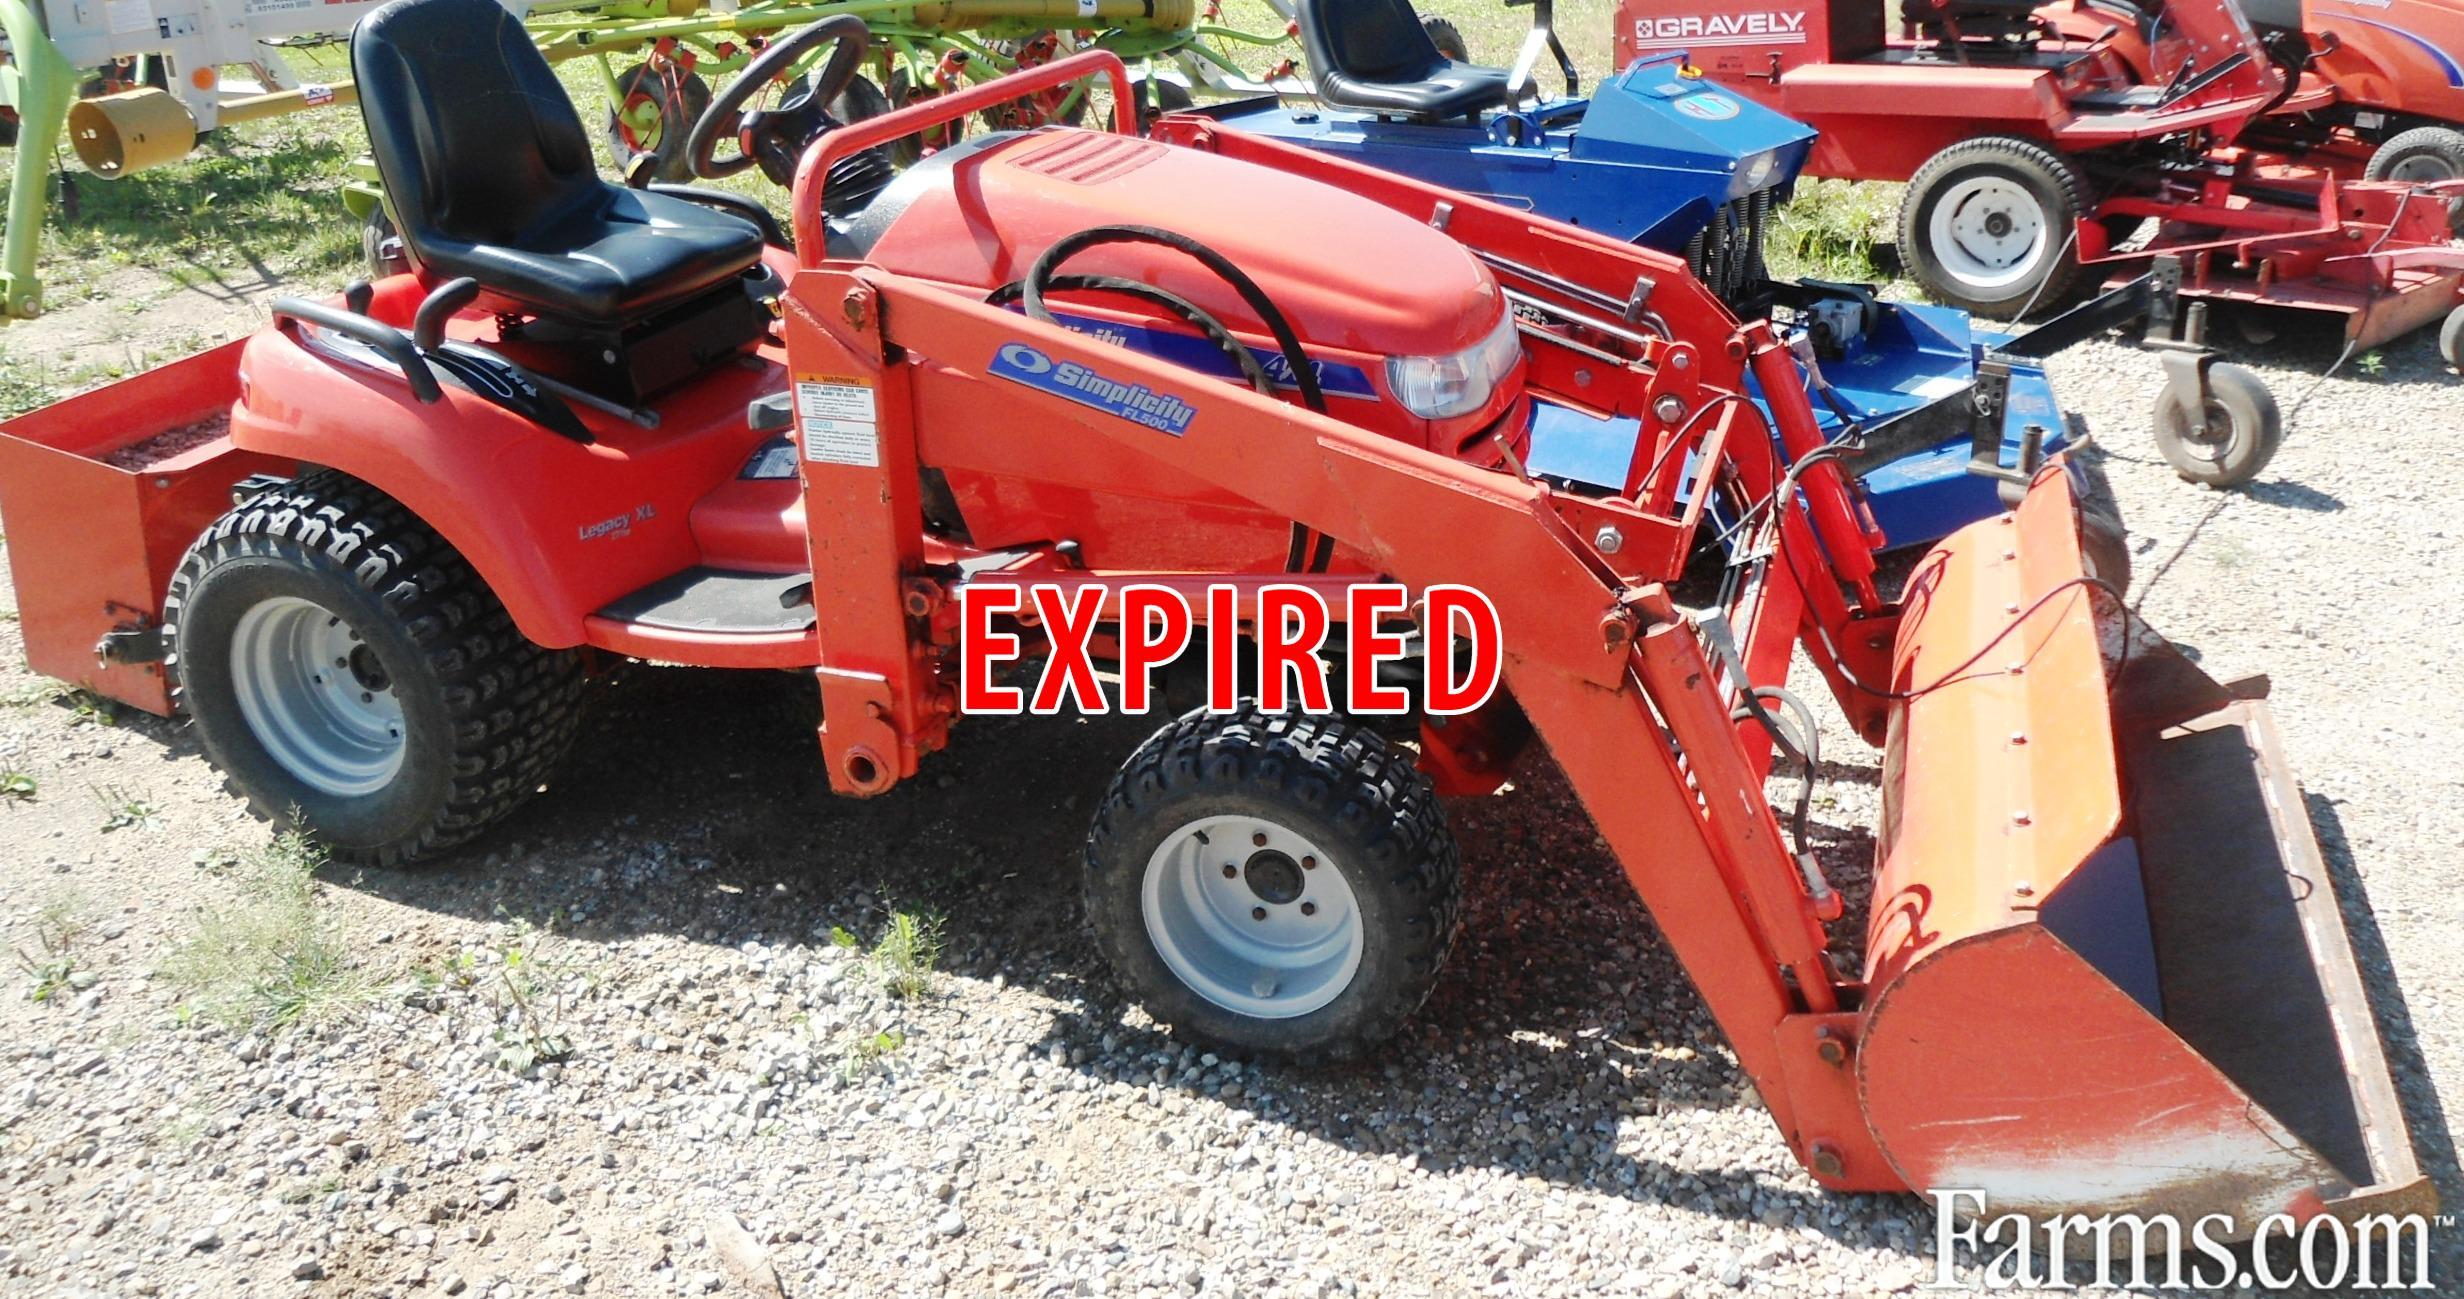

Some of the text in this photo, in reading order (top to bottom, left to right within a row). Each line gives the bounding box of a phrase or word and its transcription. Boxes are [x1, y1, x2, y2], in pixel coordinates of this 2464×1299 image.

[1655, 12, 1806, 37] GRAVELY
[822, 375, 860, 386] WARNING
[1053, 361, 1193, 428] Simplicity
[1121, 408, 1169, 431] FL500
[579, 513, 631, 540] Legacy
[635, 503, 656, 521] XL
